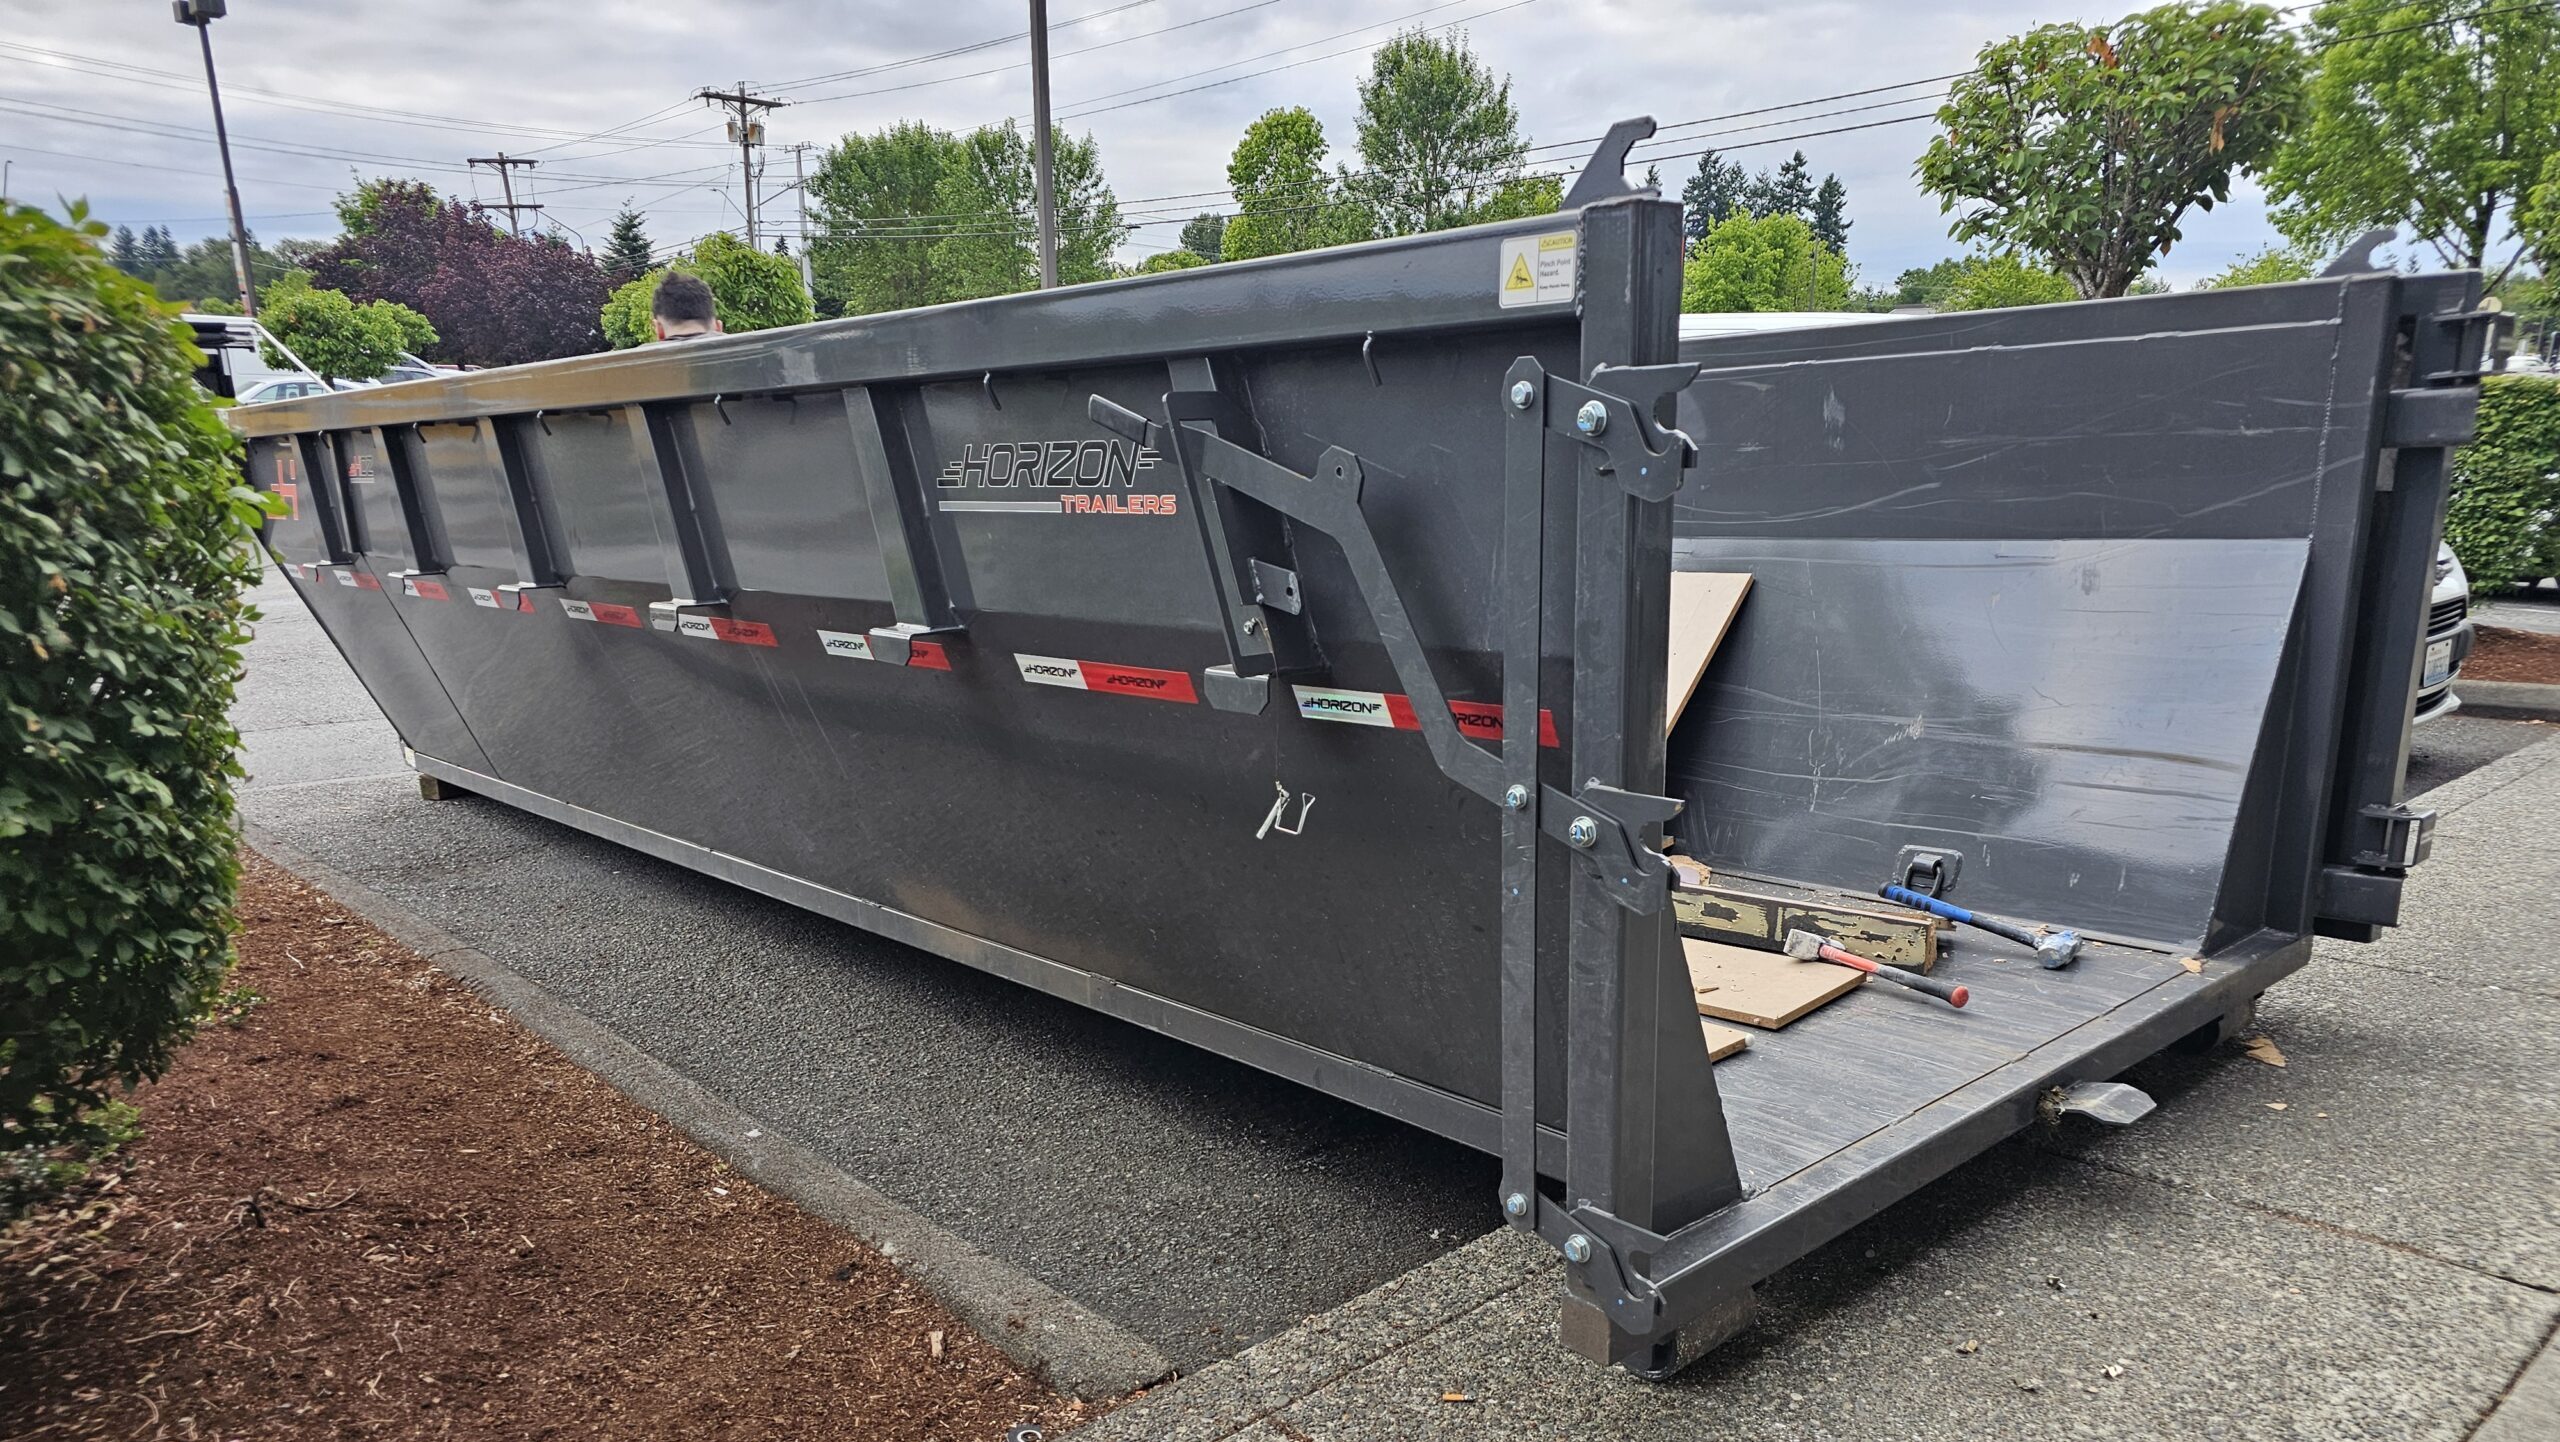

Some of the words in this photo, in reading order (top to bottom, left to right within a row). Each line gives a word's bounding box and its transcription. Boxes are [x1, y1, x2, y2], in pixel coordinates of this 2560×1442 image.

[960, 439, 1139, 488] HORIZON
[1060, 494, 1177, 515] TRAILERS
[1028, 663, 1072, 678] HORIZON
[1110, 674, 1162, 690] HORIZON
[1310, 697, 1374, 715] HORIZON
[1453, 712, 1503, 729] RIZON
